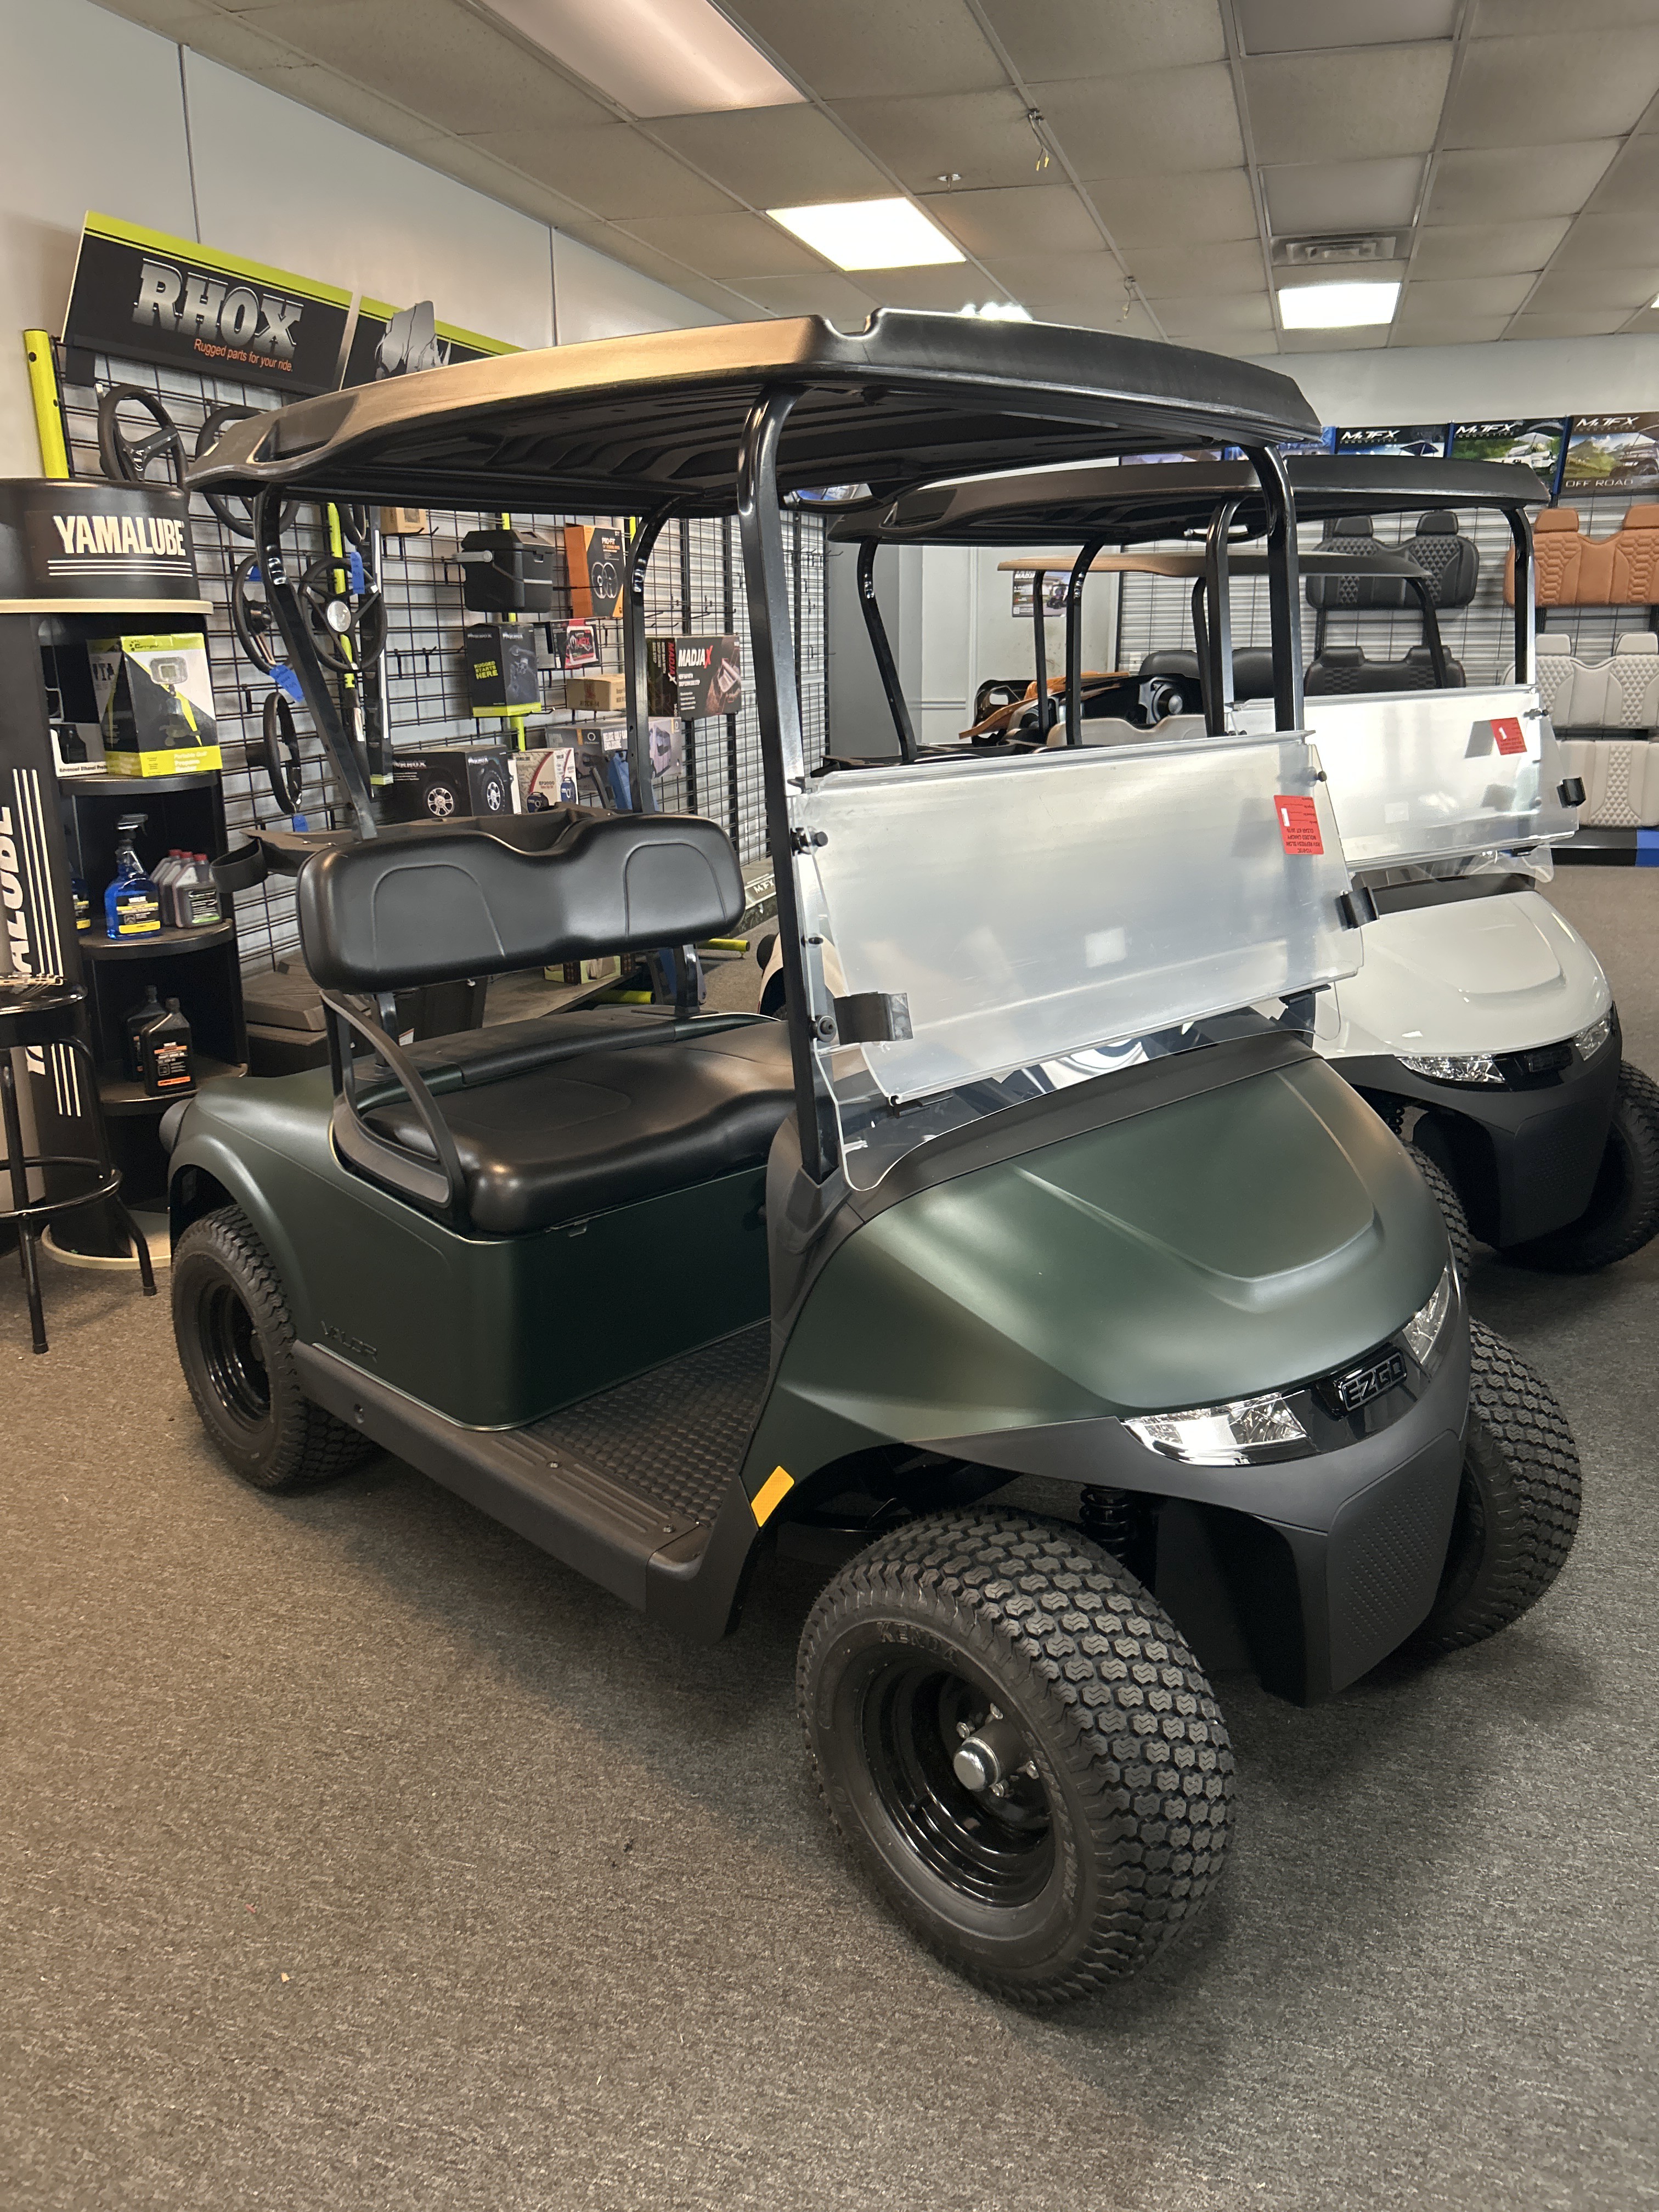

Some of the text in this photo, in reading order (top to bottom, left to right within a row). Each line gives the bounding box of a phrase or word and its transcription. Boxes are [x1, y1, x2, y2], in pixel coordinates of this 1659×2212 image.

[132, 257, 304, 360] RHOX
[194, 338, 226, 357] Rugged
[227, 349, 247, 362] parts
[249, 351, 258, 364] for
[259, 356, 276, 368] your
[53, 515, 186, 556] YAMALUBE
[476, 665, 496, 673] STARTS
[476, 670, 498, 680] HERE
[668, 642, 678, 685] MADJAX
[678, 645, 713, 669] MADJAX
[1341, 1351, 1408, 1412] EZGO
[876, 1621, 958, 1667] KENDA
